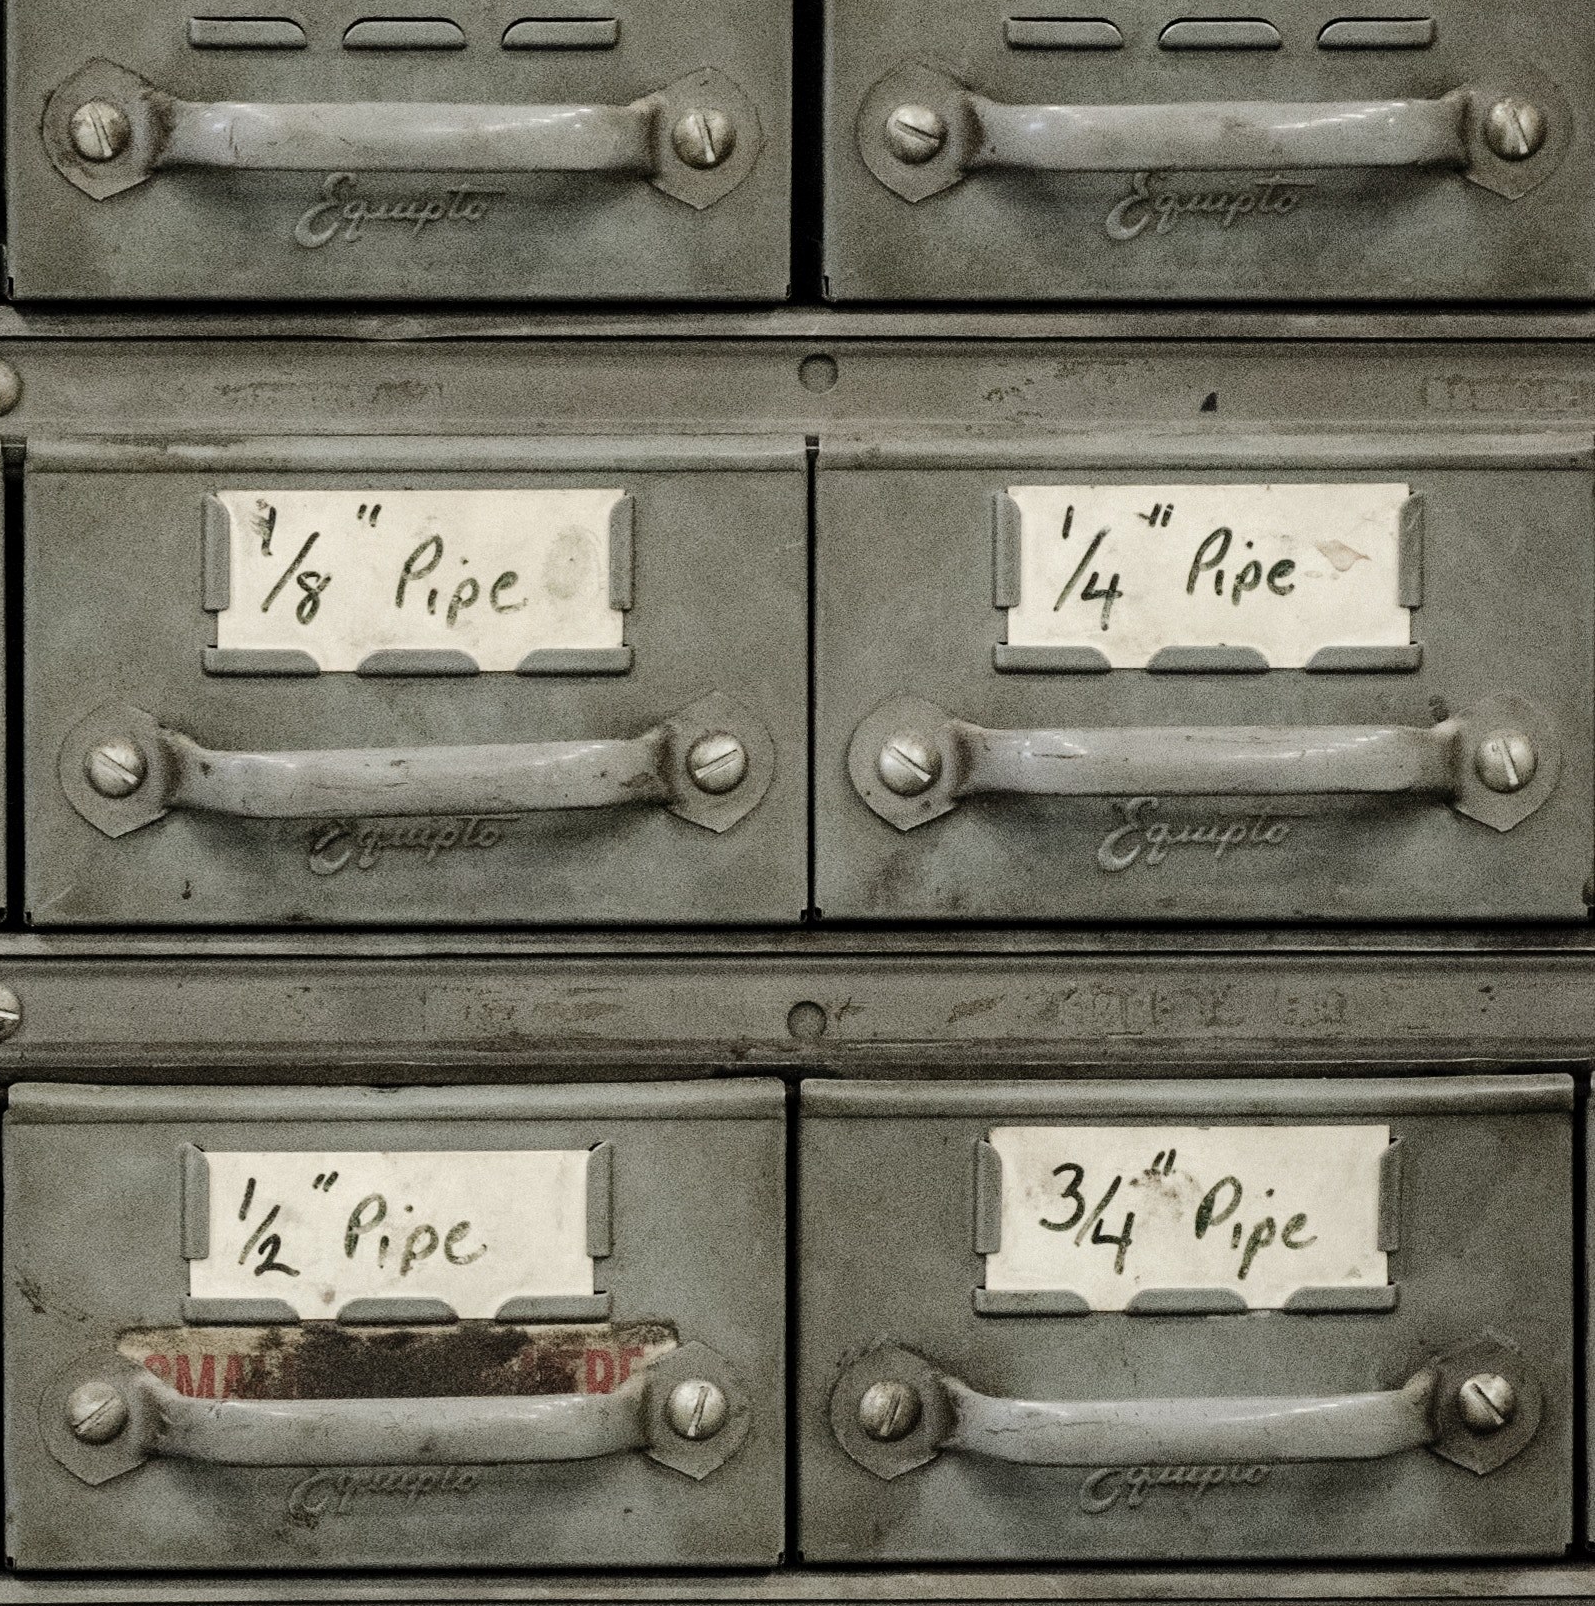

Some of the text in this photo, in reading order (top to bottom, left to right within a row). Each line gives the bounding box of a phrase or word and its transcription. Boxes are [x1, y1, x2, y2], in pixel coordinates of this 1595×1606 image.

[394, 533, 529, 628] Pipe
[1185, 526, 1296, 606] Pipe
[343, 1193, 488, 1275] Pipe
[1194, 1175, 1318, 1279] Pipe
